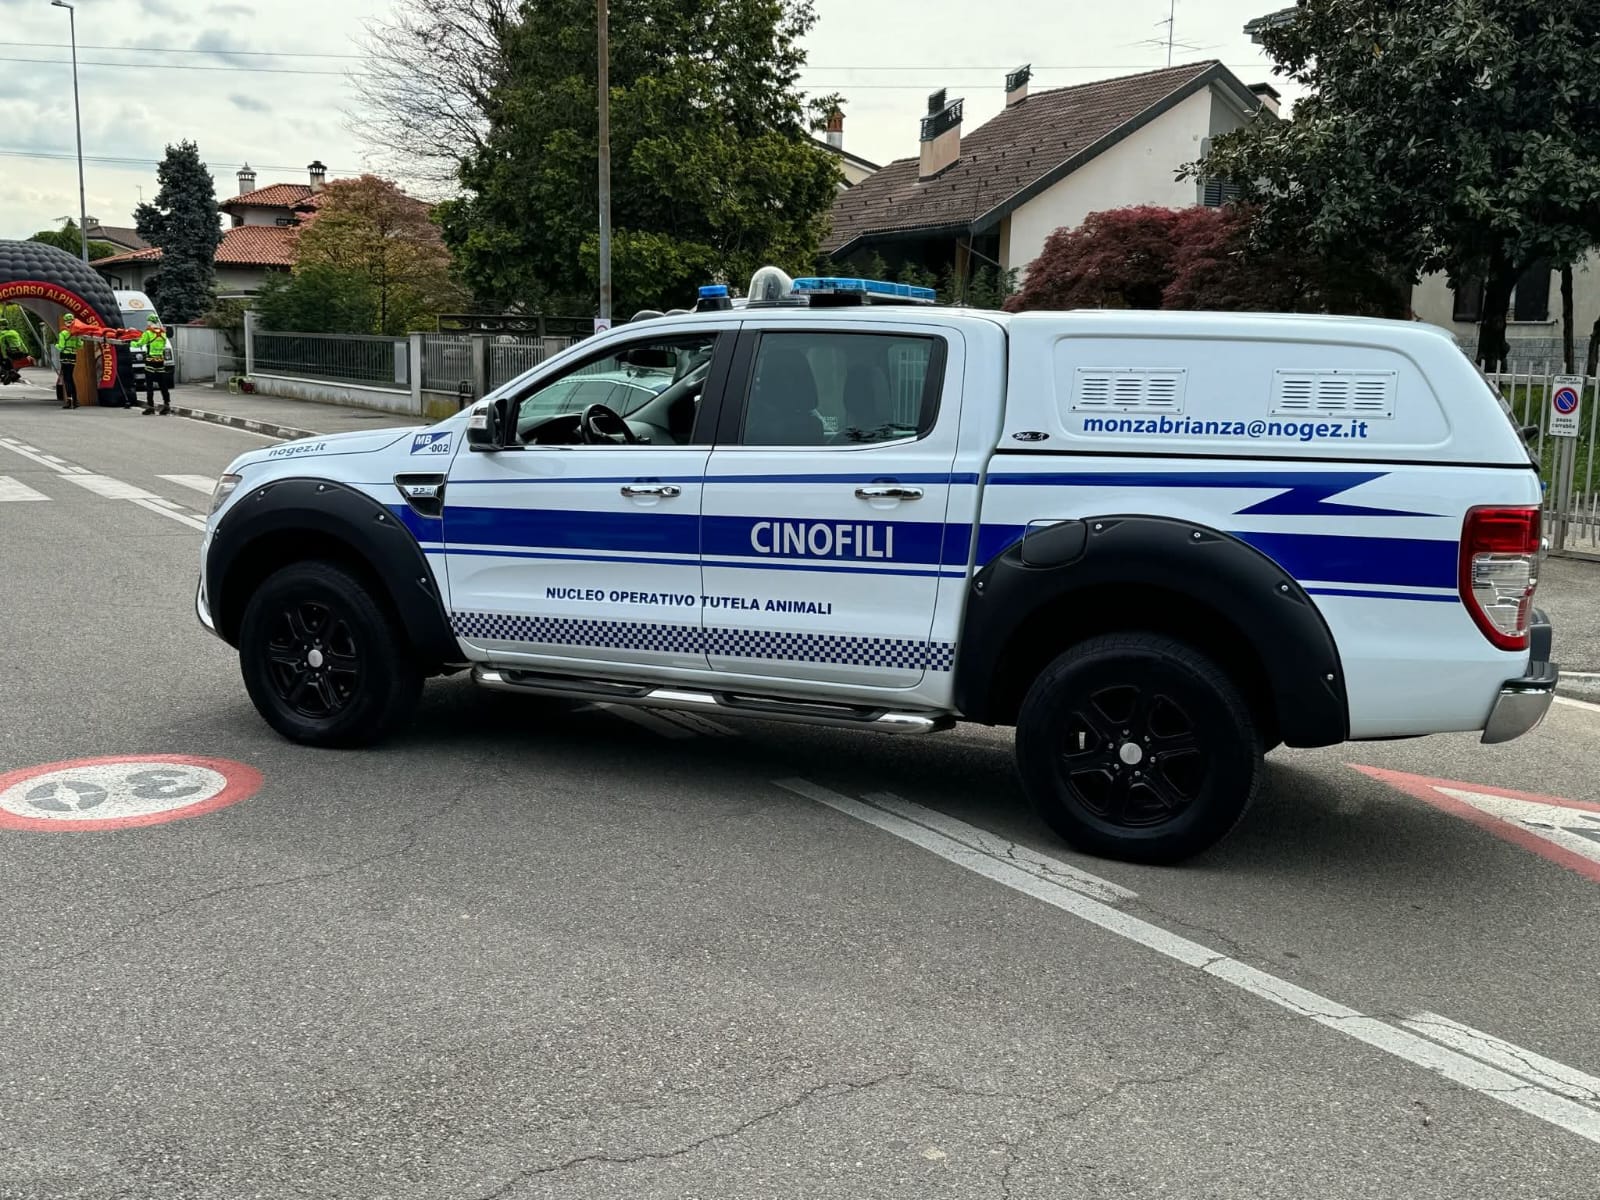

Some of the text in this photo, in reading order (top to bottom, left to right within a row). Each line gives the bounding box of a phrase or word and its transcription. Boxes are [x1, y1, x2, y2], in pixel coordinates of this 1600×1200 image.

[46, 289, 81, 312] ALPINO
[79, 309, 89, 318] E
[415, 435, 432, 445] MB
[1083, 416, 1368, 442] monzabrianza@nogez.it
[268, 442, 327, 457] nogez.it
[429, 444, 449, 453] -002
[750, 521, 894, 559] CINOFILI
[546, 587, 833, 616] NUCLEO OPERATIVO TUTELA ANIMALI
